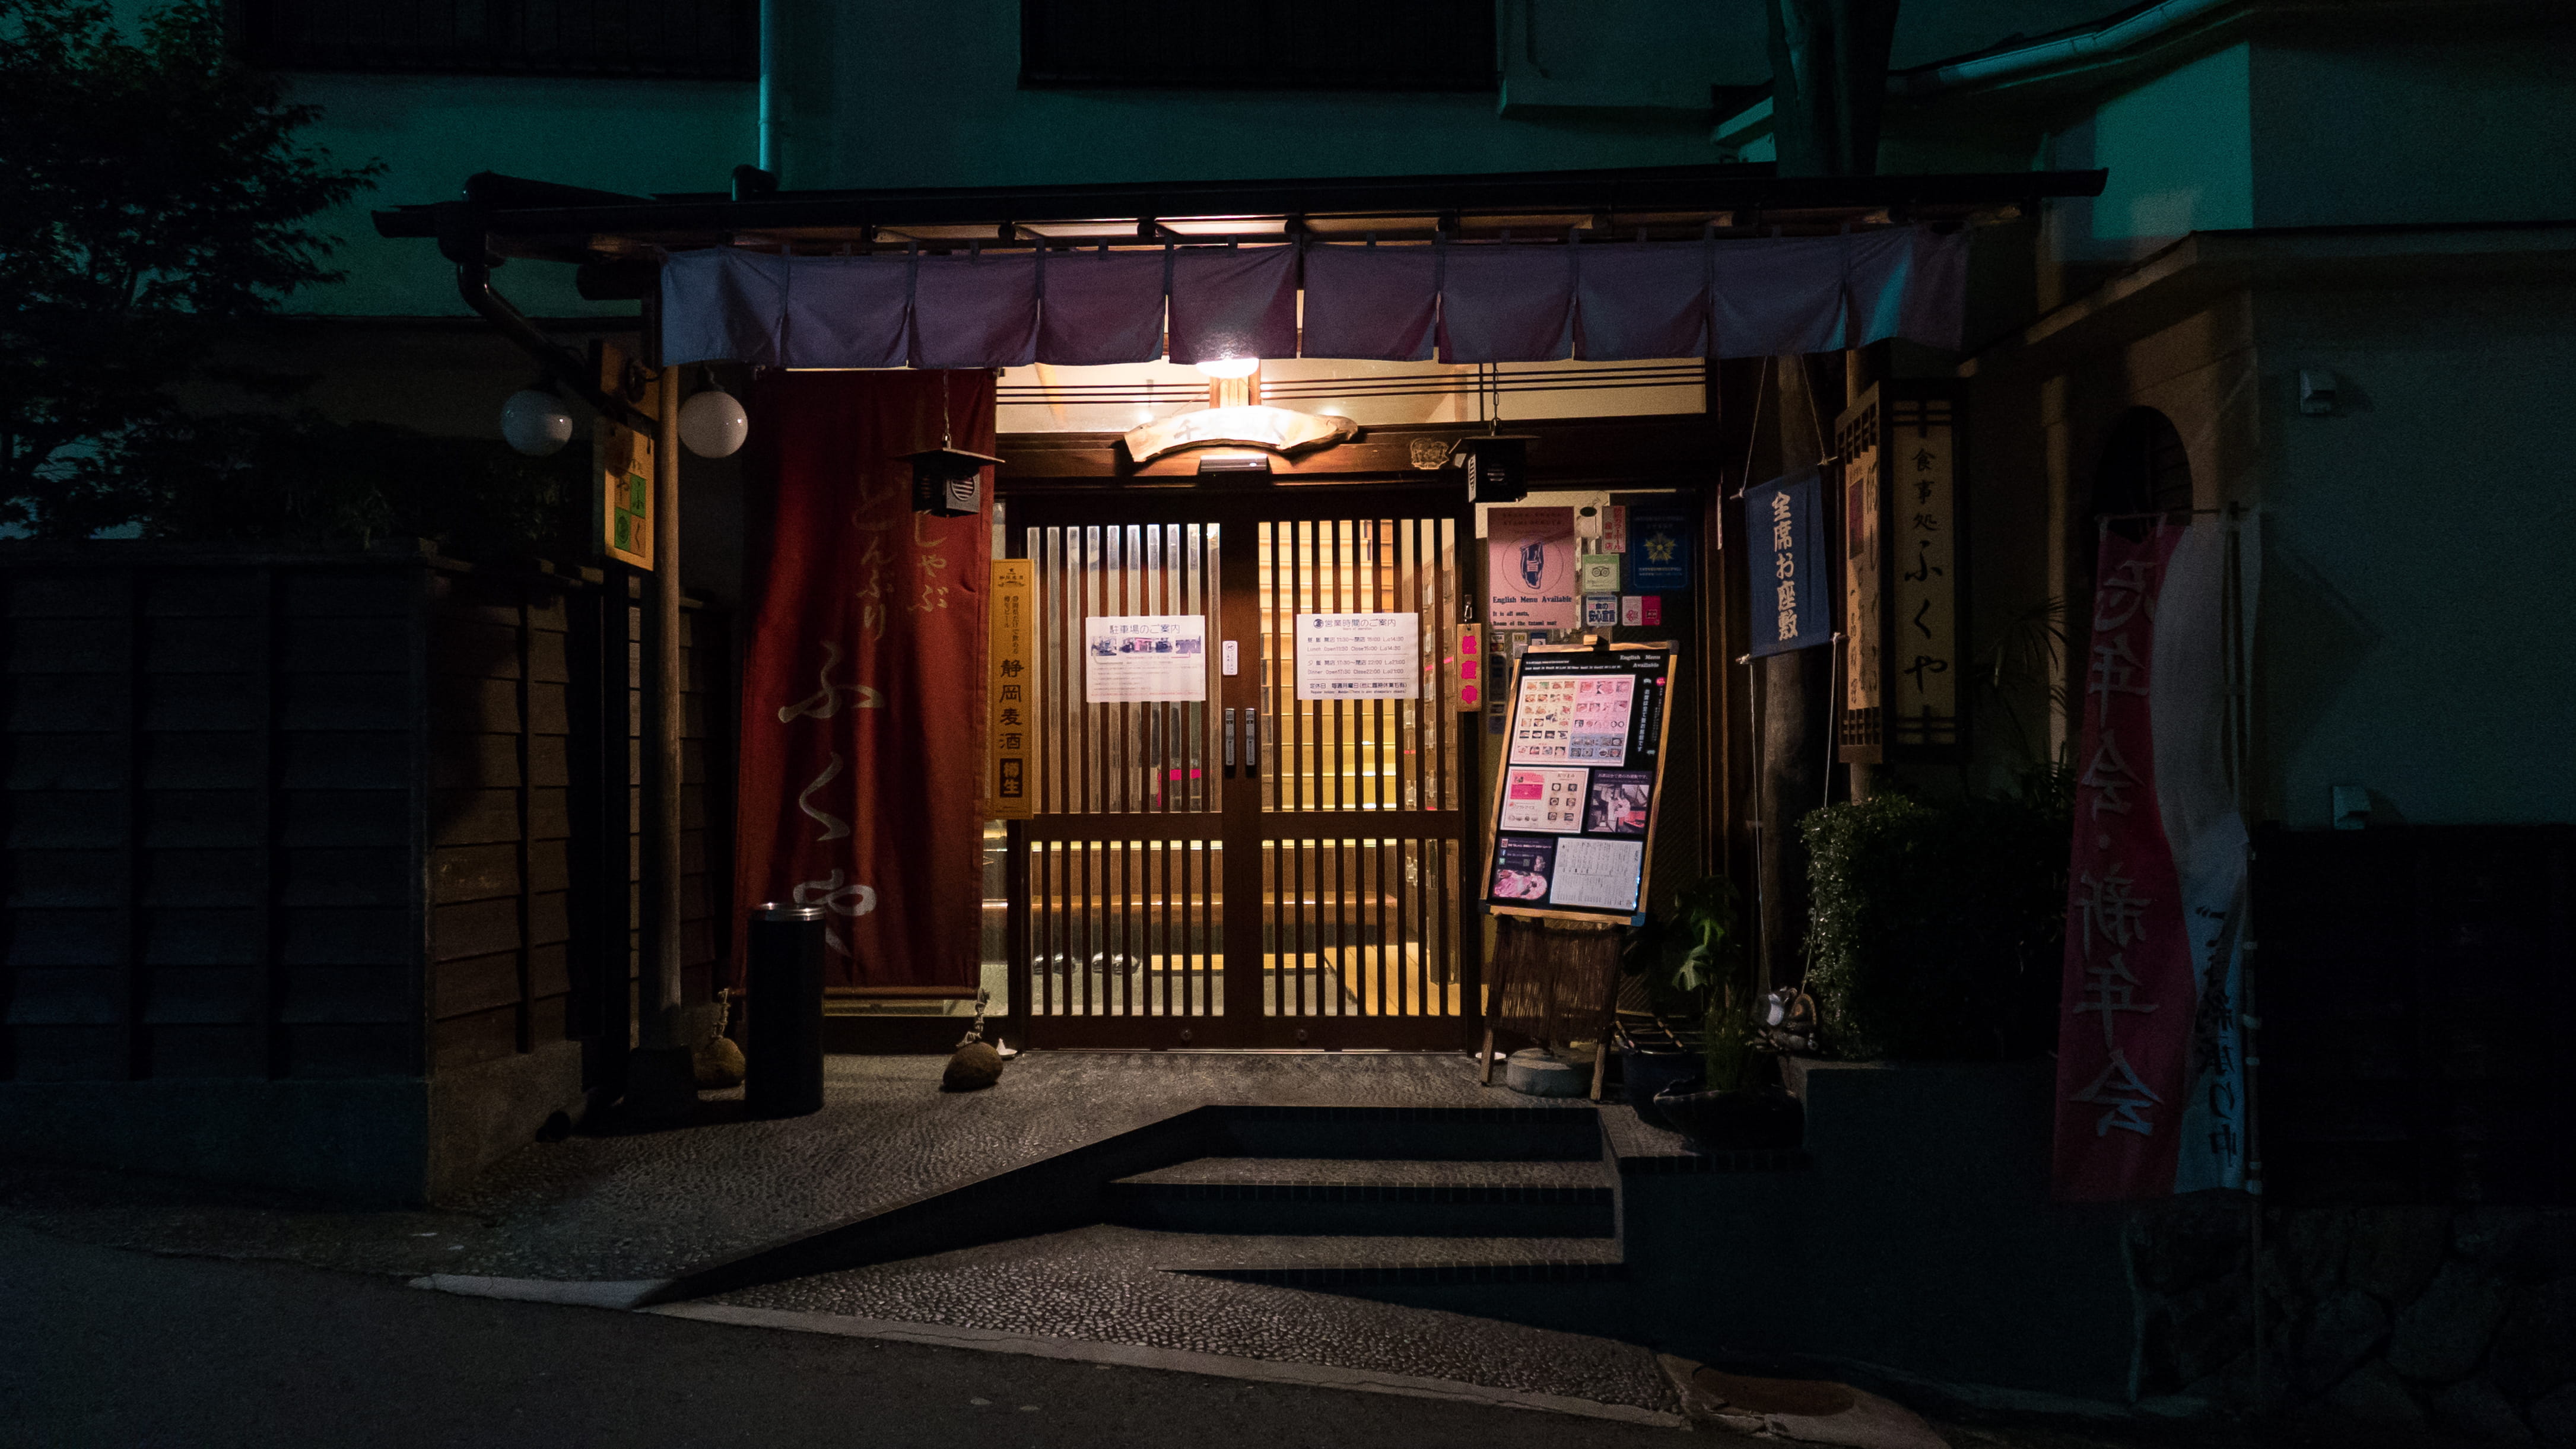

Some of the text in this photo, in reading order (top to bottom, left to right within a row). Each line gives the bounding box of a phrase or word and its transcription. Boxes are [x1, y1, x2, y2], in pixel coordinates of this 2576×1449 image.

[1771, 491, 1799, 641] 全席お座敷
[1904, 447, 1949, 694] 食事処 ふくや
[1110, 624, 1180, 635] 駐車場のご案内
[1324, 619, 1396, 627] 営業時間のご案内
[999, 659, 1024, 749] 静岡麦酒
